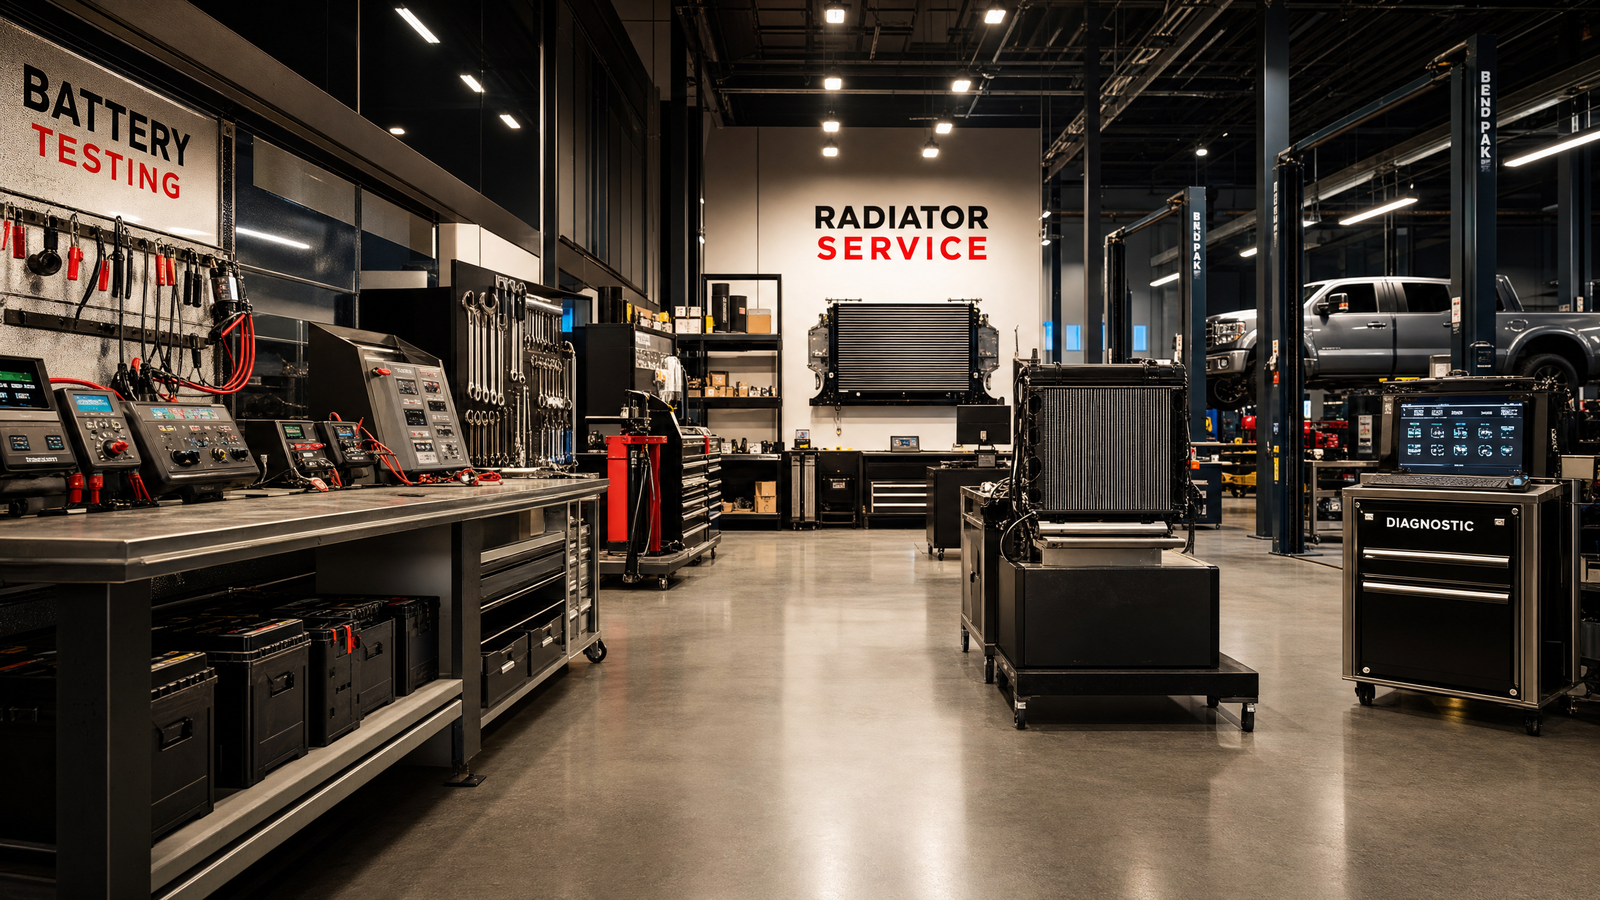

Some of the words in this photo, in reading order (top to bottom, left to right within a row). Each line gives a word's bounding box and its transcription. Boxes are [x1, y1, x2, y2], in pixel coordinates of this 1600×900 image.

[23, 62, 191, 167] BATTERY
[31, 122, 181, 200] TESTING
[815, 205, 989, 229] RADIATOR
[817, 236, 987, 260] SERVICE
[1386, 516, 1475, 532] DIAGNOSTIC
